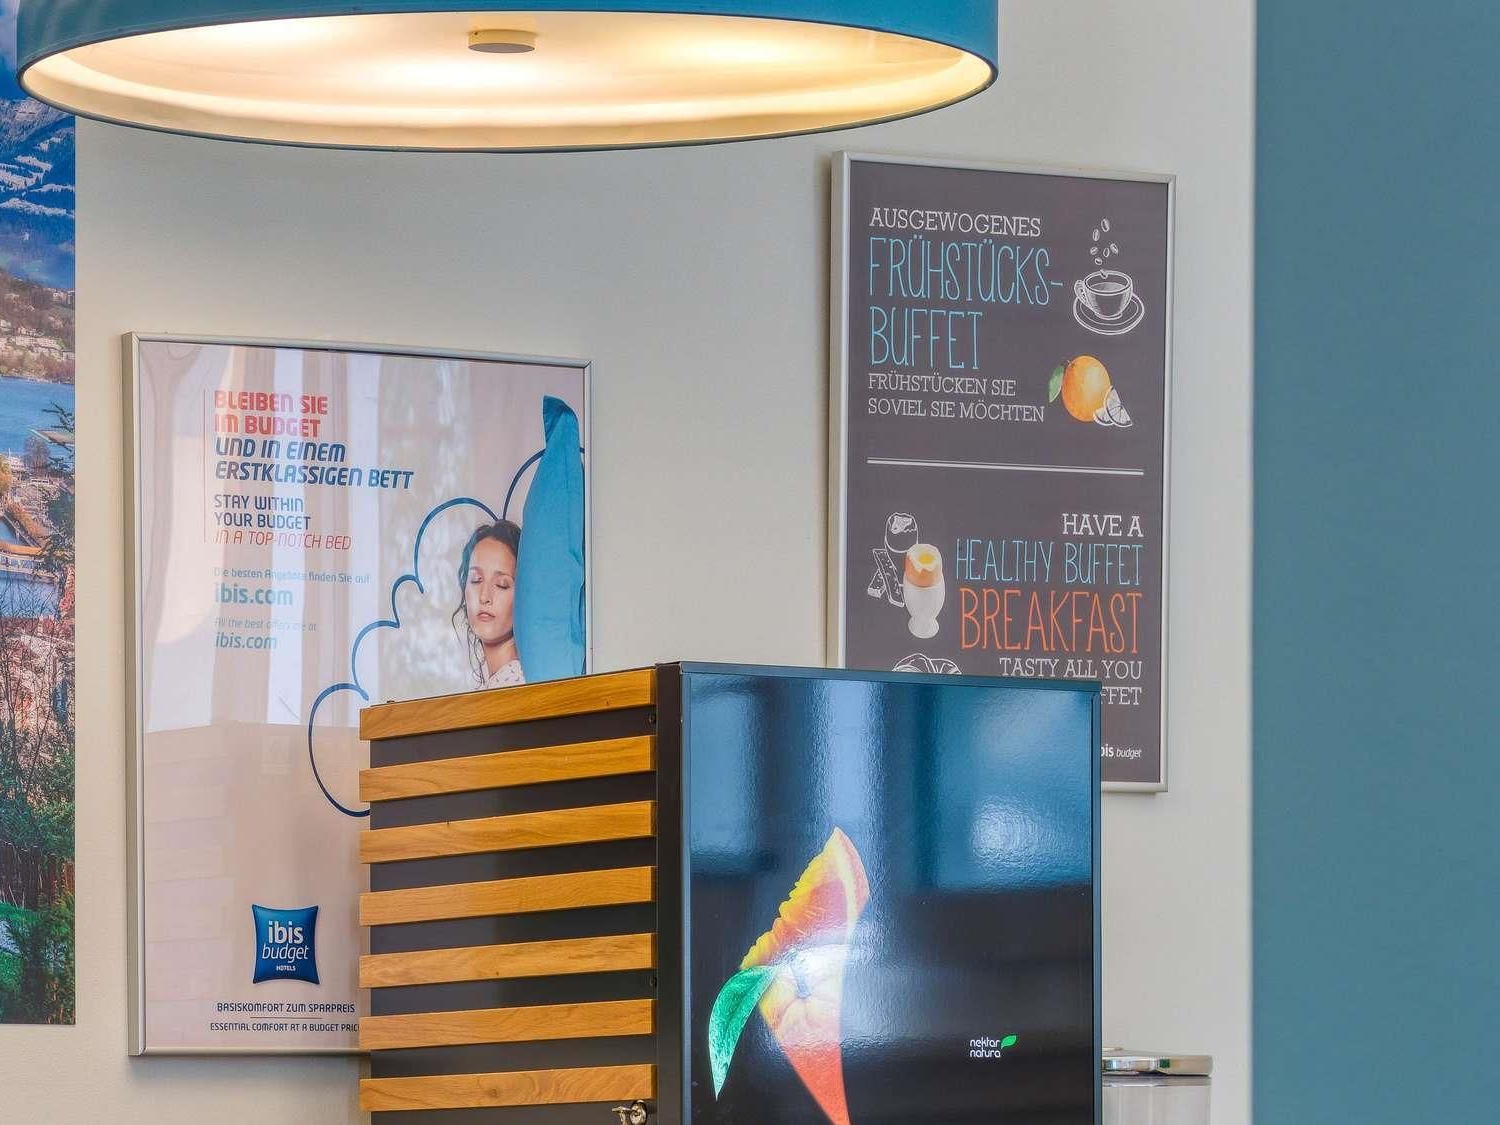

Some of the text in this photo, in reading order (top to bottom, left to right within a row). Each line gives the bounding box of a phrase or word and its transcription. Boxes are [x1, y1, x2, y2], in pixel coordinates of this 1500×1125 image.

[869, 207, 1041, 237] AUSGEWOGENES
[869, 234, 1063, 305] FRÜHSTÜCKS-
[869, 306, 983, 369] BUFFET
[868, 370, 1016, 396] FRÜHSTÜCKEN SIE
[214, 390, 328, 415] BLEIBEN SIE
[868, 398, 1045, 422] SOVIEL SIE MÖCHTEN
[214, 414, 321, 438] IM BUDGET
[215, 437, 346, 462] UND IN EINEM
[215, 461, 414, 489] ERSTKLASSIGEN BETT
[214, 494, 304, 512] STAY WITHIN
[214, 512, 311, 530] YOUR BUDGET
[1062, 513, 1144, 537] HAVE A
[215, 530, 229, 544] IN
[233, 531, 243, 545] A
[325, 535, 352, 550] BED
[956, 538, 1143, 586] HEALTHY BUFFET
[231, 567, 263, 579] besten
[308, 571, 337, 582] finden
[338, 573, 352, 583] Sie
[214, 582, 293, 606] ibis.com
[960, 587, 1142, 654] BREAKFAST
[215, 632, 277, 649] ibis.com
[999, 657, 1143, 680] TASTY ALL YOU
[1101, 686, 1142, 705] FFET
[1116, 748, 1142, 760] budget
[268, 921, 304, 944] ibis
[262, 943, 309, 963] budget
[217, 1002, 355, 1013] BASISKOMFORT ZUM SPARPREIS
[210, 1022, 360, 1032] ESSENTIAL COMFORT AT A BUDGET PRIC
[969, 1036, 1000, 1048] nektar
[969, 1048, 1001, 1058] natura
